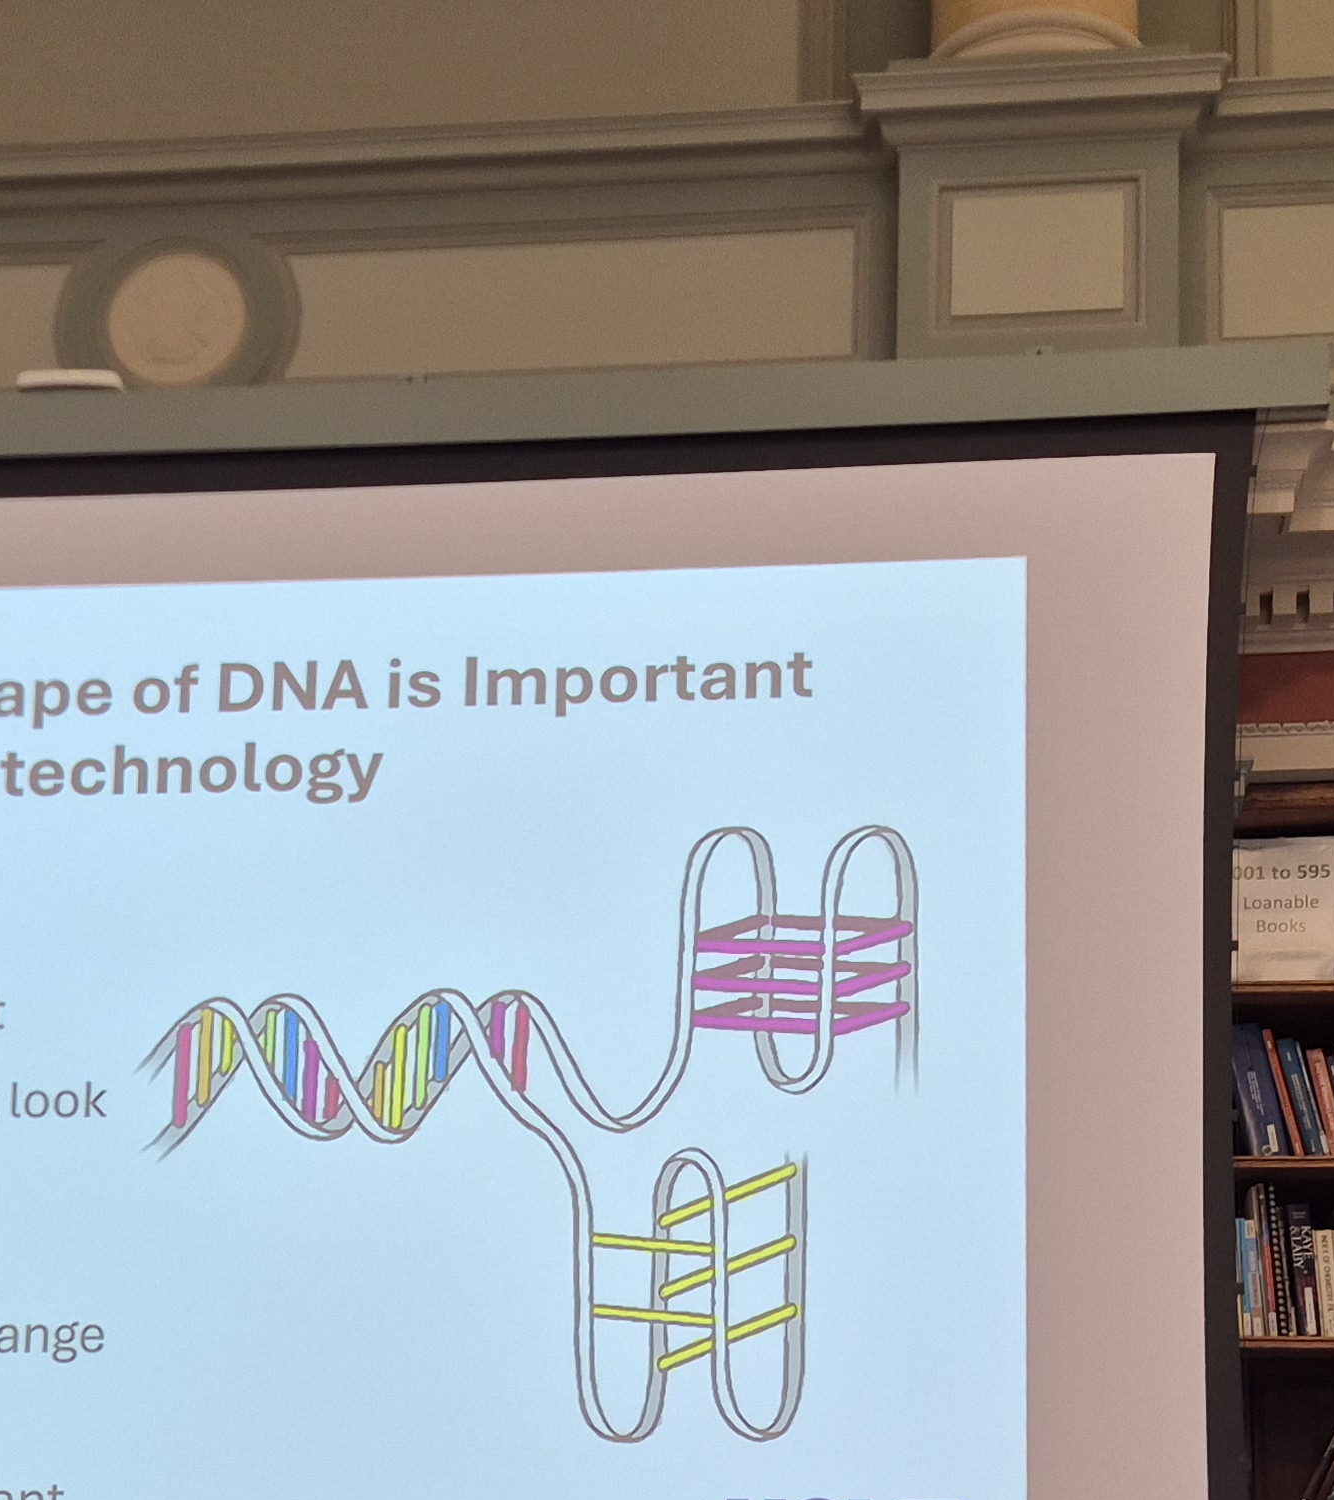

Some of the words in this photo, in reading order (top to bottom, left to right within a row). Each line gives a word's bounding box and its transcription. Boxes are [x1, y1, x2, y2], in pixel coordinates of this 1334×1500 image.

[133, 663, 199, 714] of
[218, 659, 369, 713] DNA
[388, 671, 441, 709] is
[464, 652, 813, 718] Important
[1271, 866, 1291, 879] to
[1297, 863, 1331, 879] 595
[1243, 894, 1320, 911] Loanable
[1256, 918, 1307, 934] Books
[10, 1081, 107, 1119] look
[1301, 1225, 1313, 1260] KAYE
[1323, 1265, 1334, 1302] CHEMISTRY
